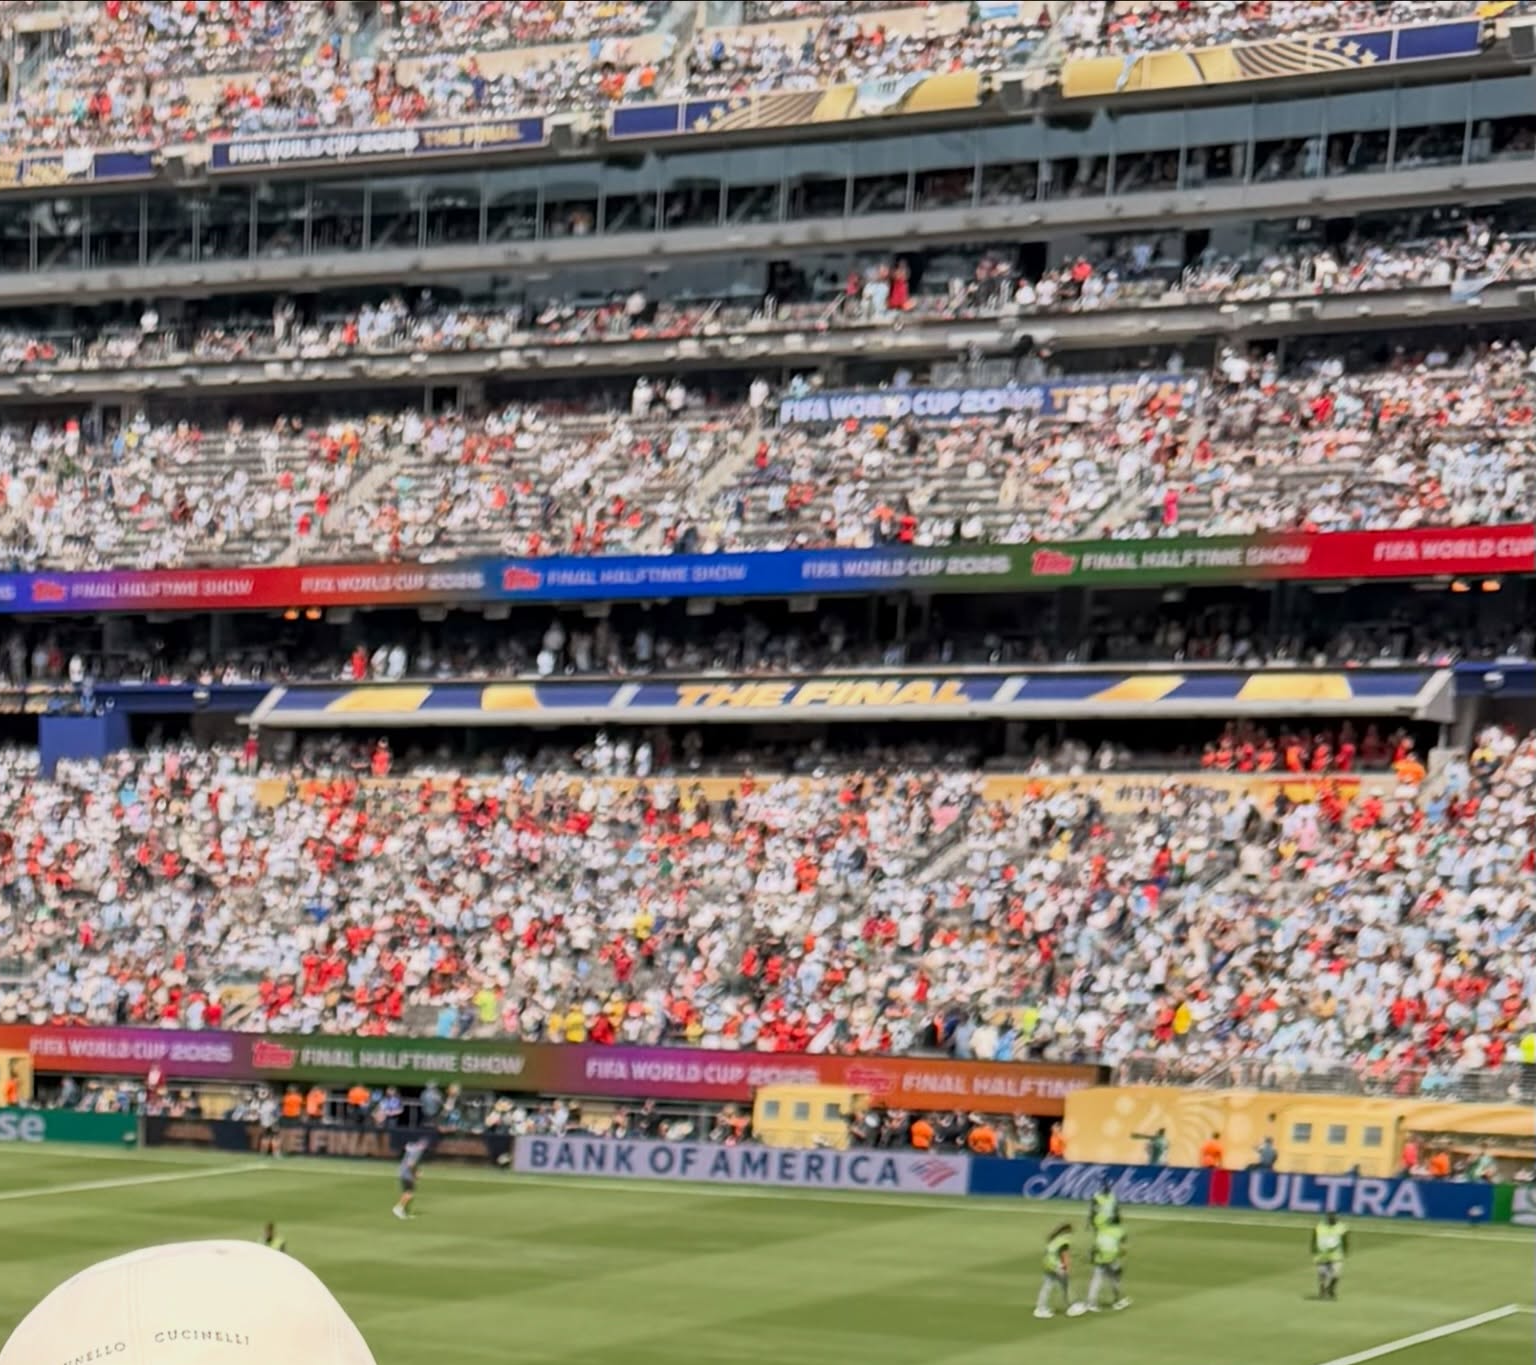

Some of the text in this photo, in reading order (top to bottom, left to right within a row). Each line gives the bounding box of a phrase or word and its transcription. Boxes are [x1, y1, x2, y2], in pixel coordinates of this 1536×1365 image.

[1080, 552, 1138, 571] FINAL
[1373, 541, 1420, 562] FIFA
[1421, 538, 1495, 560] WORLD
[801, 560, 841, 579] FIFA
[842, 558, 907, 578] WORLD
[908, 557, 946, 576] CUP
[675, 678, 972, 708] THE FINAL
[29, 1035, 233, 1064] FIFA WORLD CUP 2026
[300, 1047, 356, 1069] FINAL
[359, 1049, 458, 1073] HALFTIME
[460, 1053, 526, 1076] SHOW
[585, 1058, 629, 1081] FIFA
[631, 1060, 703, 1085] WORLD
[704, 1064, 745, 1086] CUP
[901, 1072, 968, 1096] FINAL
[246, 1124, 305, 1153] TE
[309, 1128, 394, 1157] FINAL
[529, 1140, 902, 1187] BANK OF AMERICA
[1247, 1173, 1427, 1218] ULTRA
[153, 1328, 250, 1347] CUCINELLI
